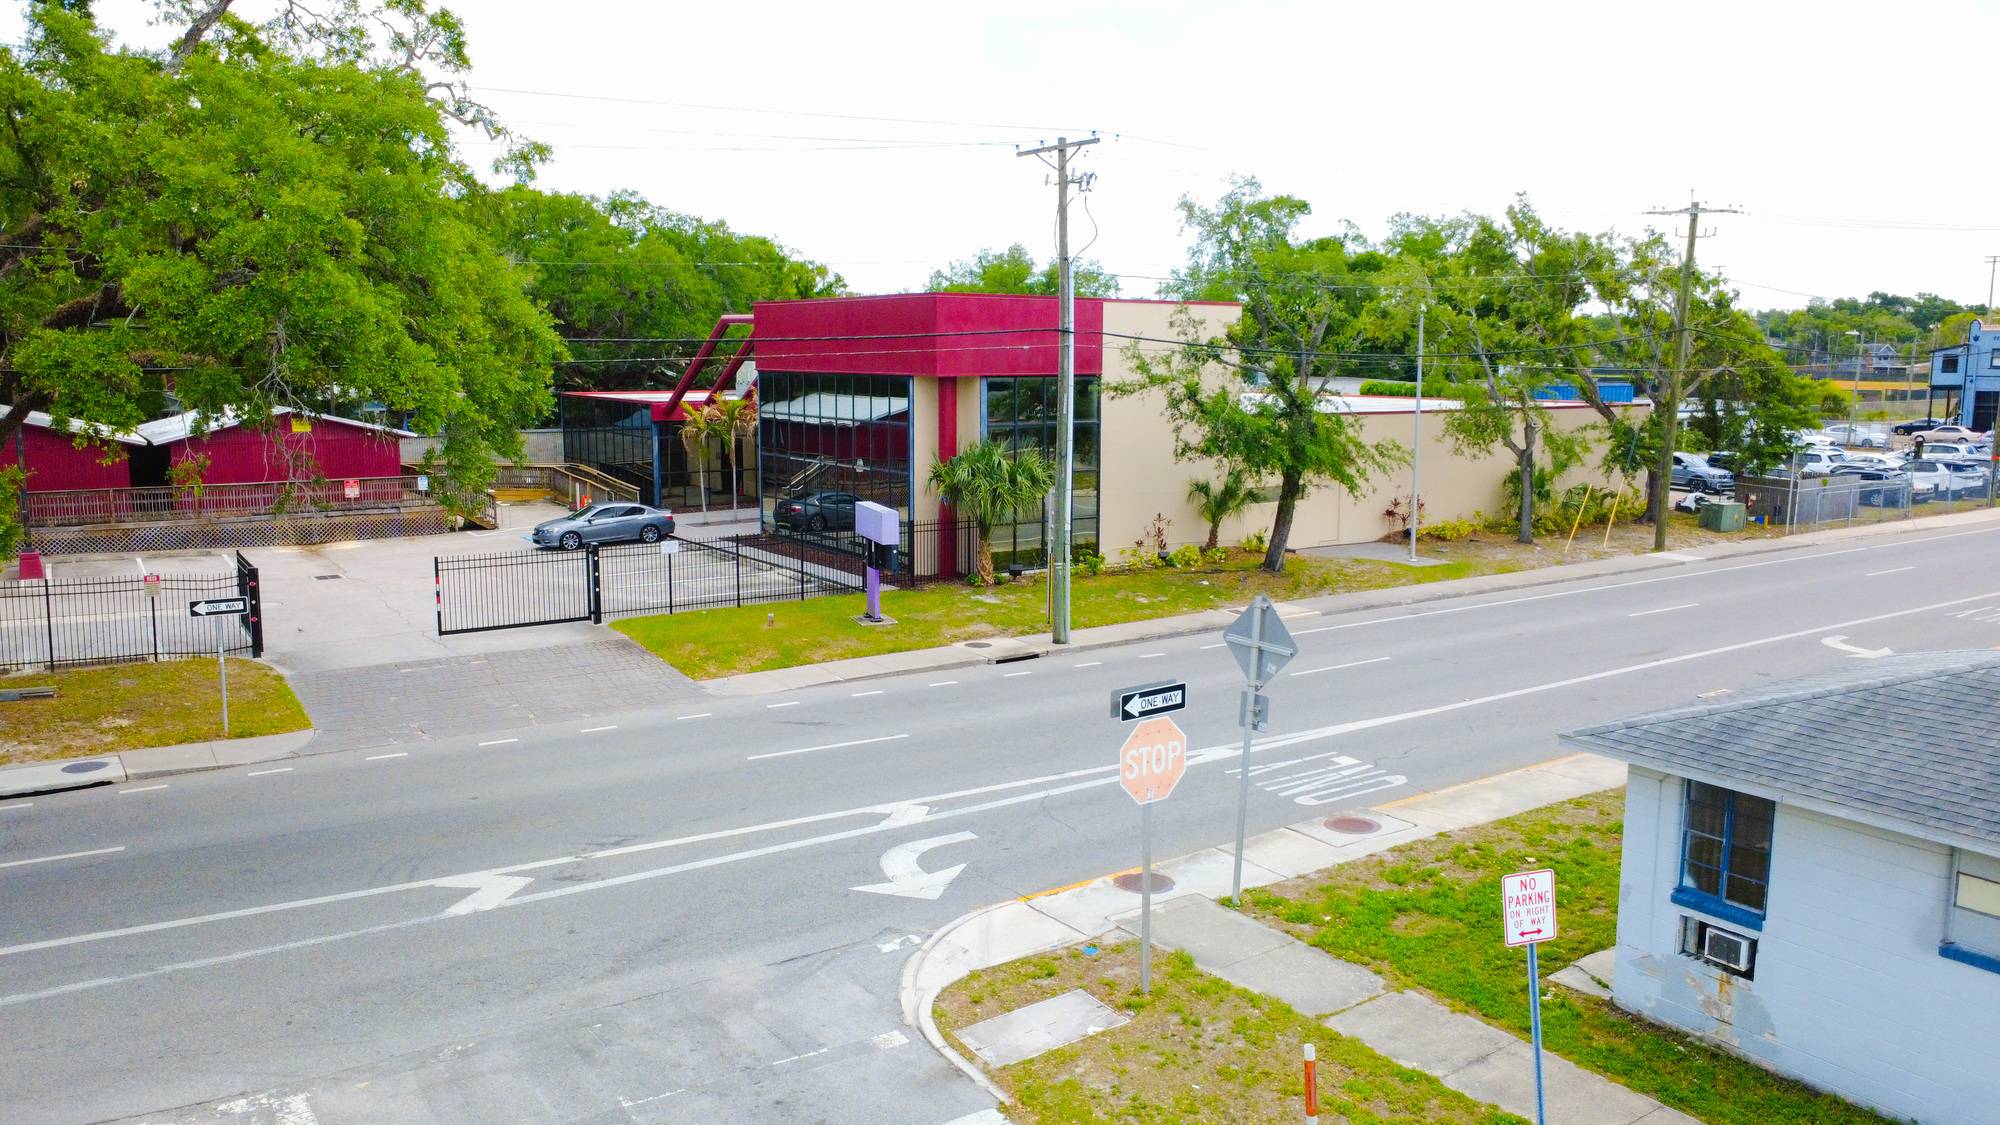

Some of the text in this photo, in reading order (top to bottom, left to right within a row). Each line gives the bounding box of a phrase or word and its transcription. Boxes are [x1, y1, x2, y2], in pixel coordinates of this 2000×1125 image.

[1140, 692, 1179, 709] ONE WAY
[1125, 740, 1183, 780] STOP
[1520, 877, 1537, 892] NO
[1508, 890, 1550, 909] PARKING
[1510, 905, 1549, 919] ON RIGHT
[1514, 916, 1546, 929] OF WAY
